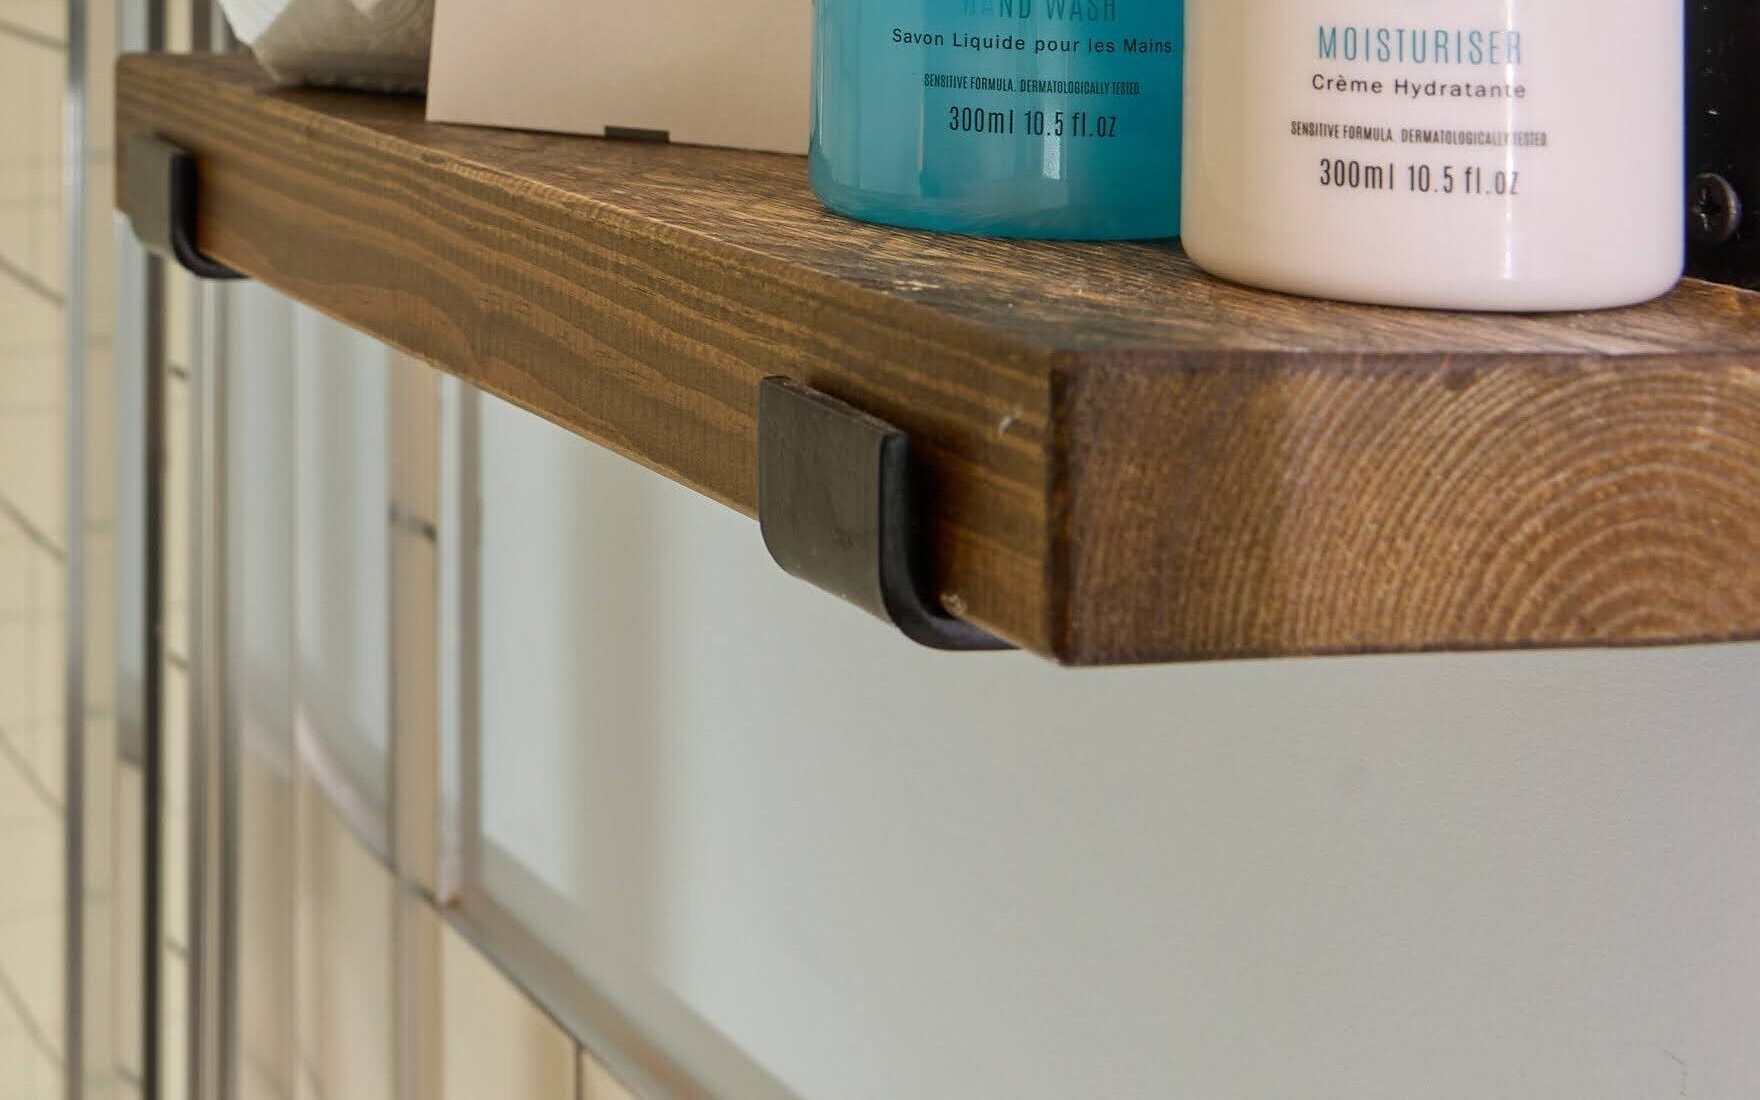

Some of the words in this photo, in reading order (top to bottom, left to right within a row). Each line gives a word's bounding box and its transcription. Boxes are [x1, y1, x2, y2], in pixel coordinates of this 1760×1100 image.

[892, 28, 944, 46] Savon
[953, 32, 1026, 52] Liquide
[1034, 38, 1080, 55] pour
[1088, 38, 1115, 52] les
[1123, 38, 1172, 53] Mains
[1318, 25, 1522, 65] MOISTURISER
[924, 73, 968, 89] SENSITIVE
[970, 76, 1016, 91] FORMULA.
[1020, 79, 1109, 95] DERMATOLOGICALLY
[1312, 73, 1383, 94] Crème
[1395, 79, 1526, 99] Hydratante
[949, 106, 1014, 134] 300ml
[1024, 110, 1064, 135] 10.5
[1072, 111, 1117, 137] fl.oz
[1290, 120, 1339, 138] SENSITIVE
[1401, 128, 1509, 146] DERMATOLOGICALLY
[1320, 158, 1394, 190] 300ml
[1407, 163, 1453, 193] 10.5
